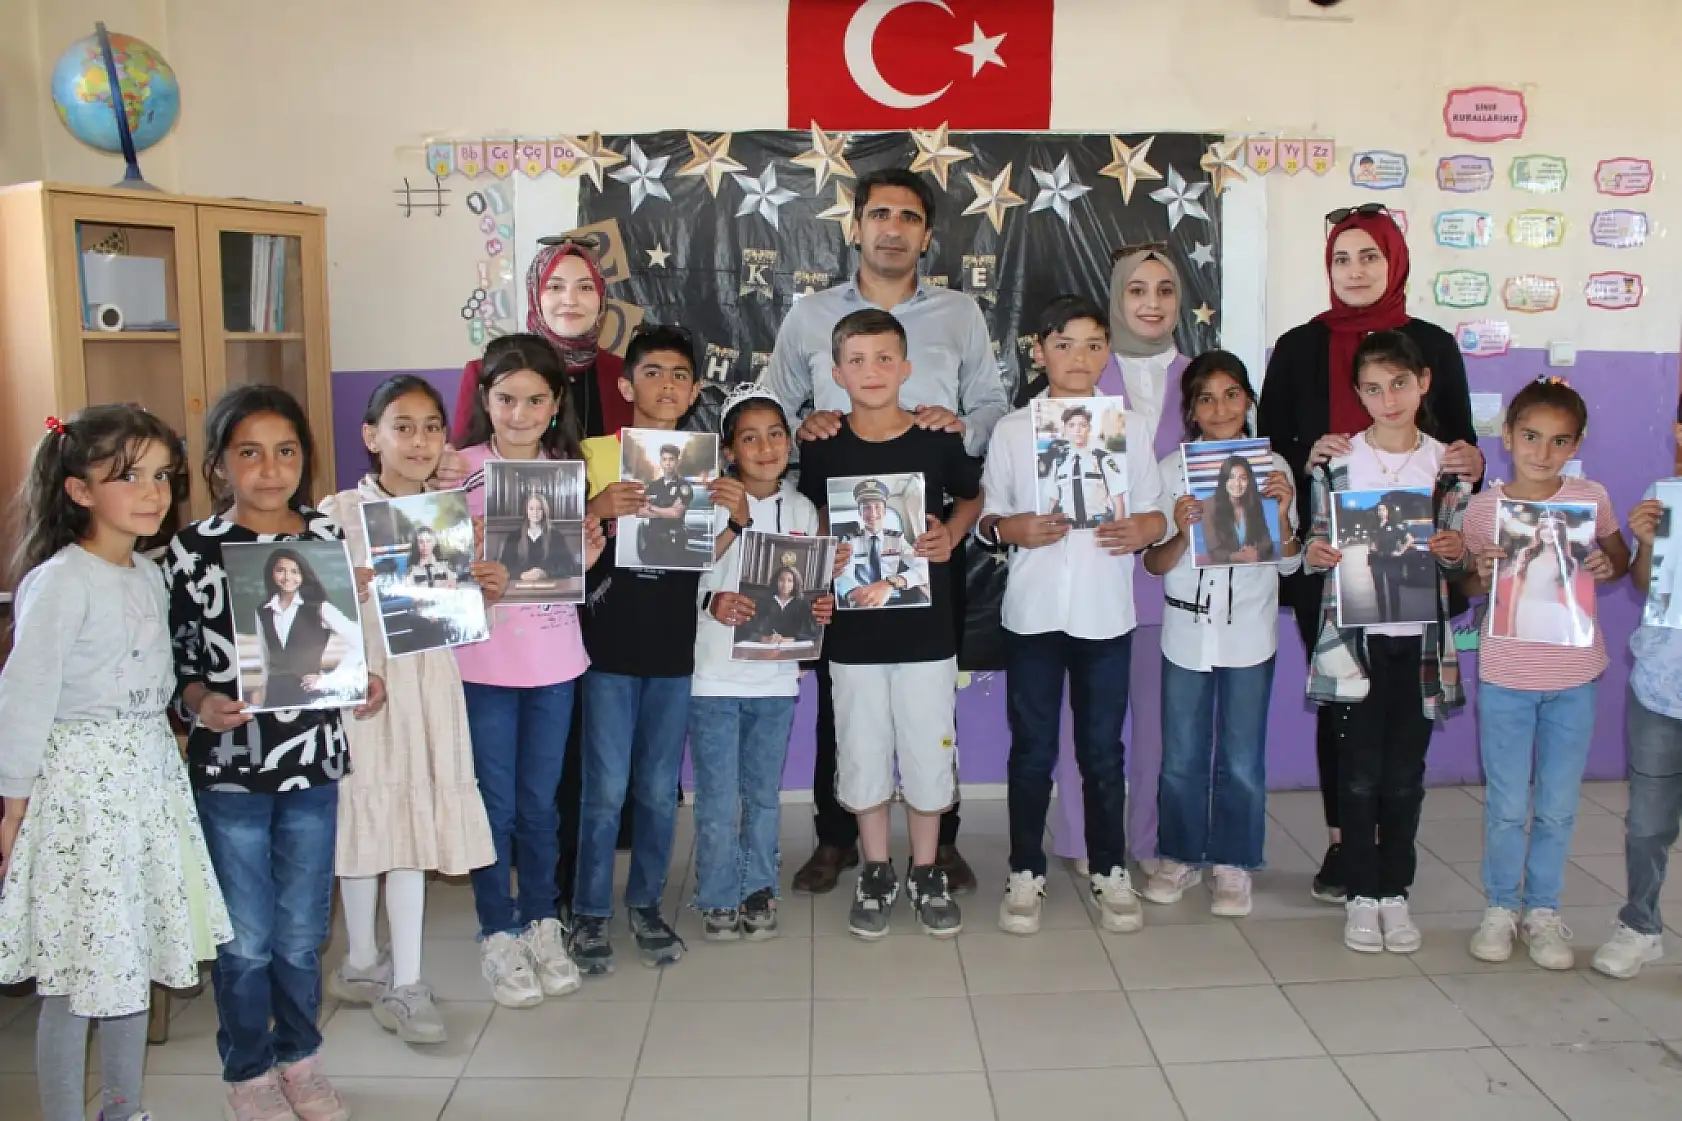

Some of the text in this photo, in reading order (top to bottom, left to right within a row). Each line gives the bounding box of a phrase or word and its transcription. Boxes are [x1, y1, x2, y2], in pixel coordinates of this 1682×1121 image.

[461, 146, 477, 159] Bb
[492, 147, 508, 159] Cc
[1285, 144, 1299, 157] Yy
[1313, 146, 1328, 157] Zz
[748, 264, 770, 285] K
[972, 267, 987, 287] E
[707, 356, 730, 381] H
